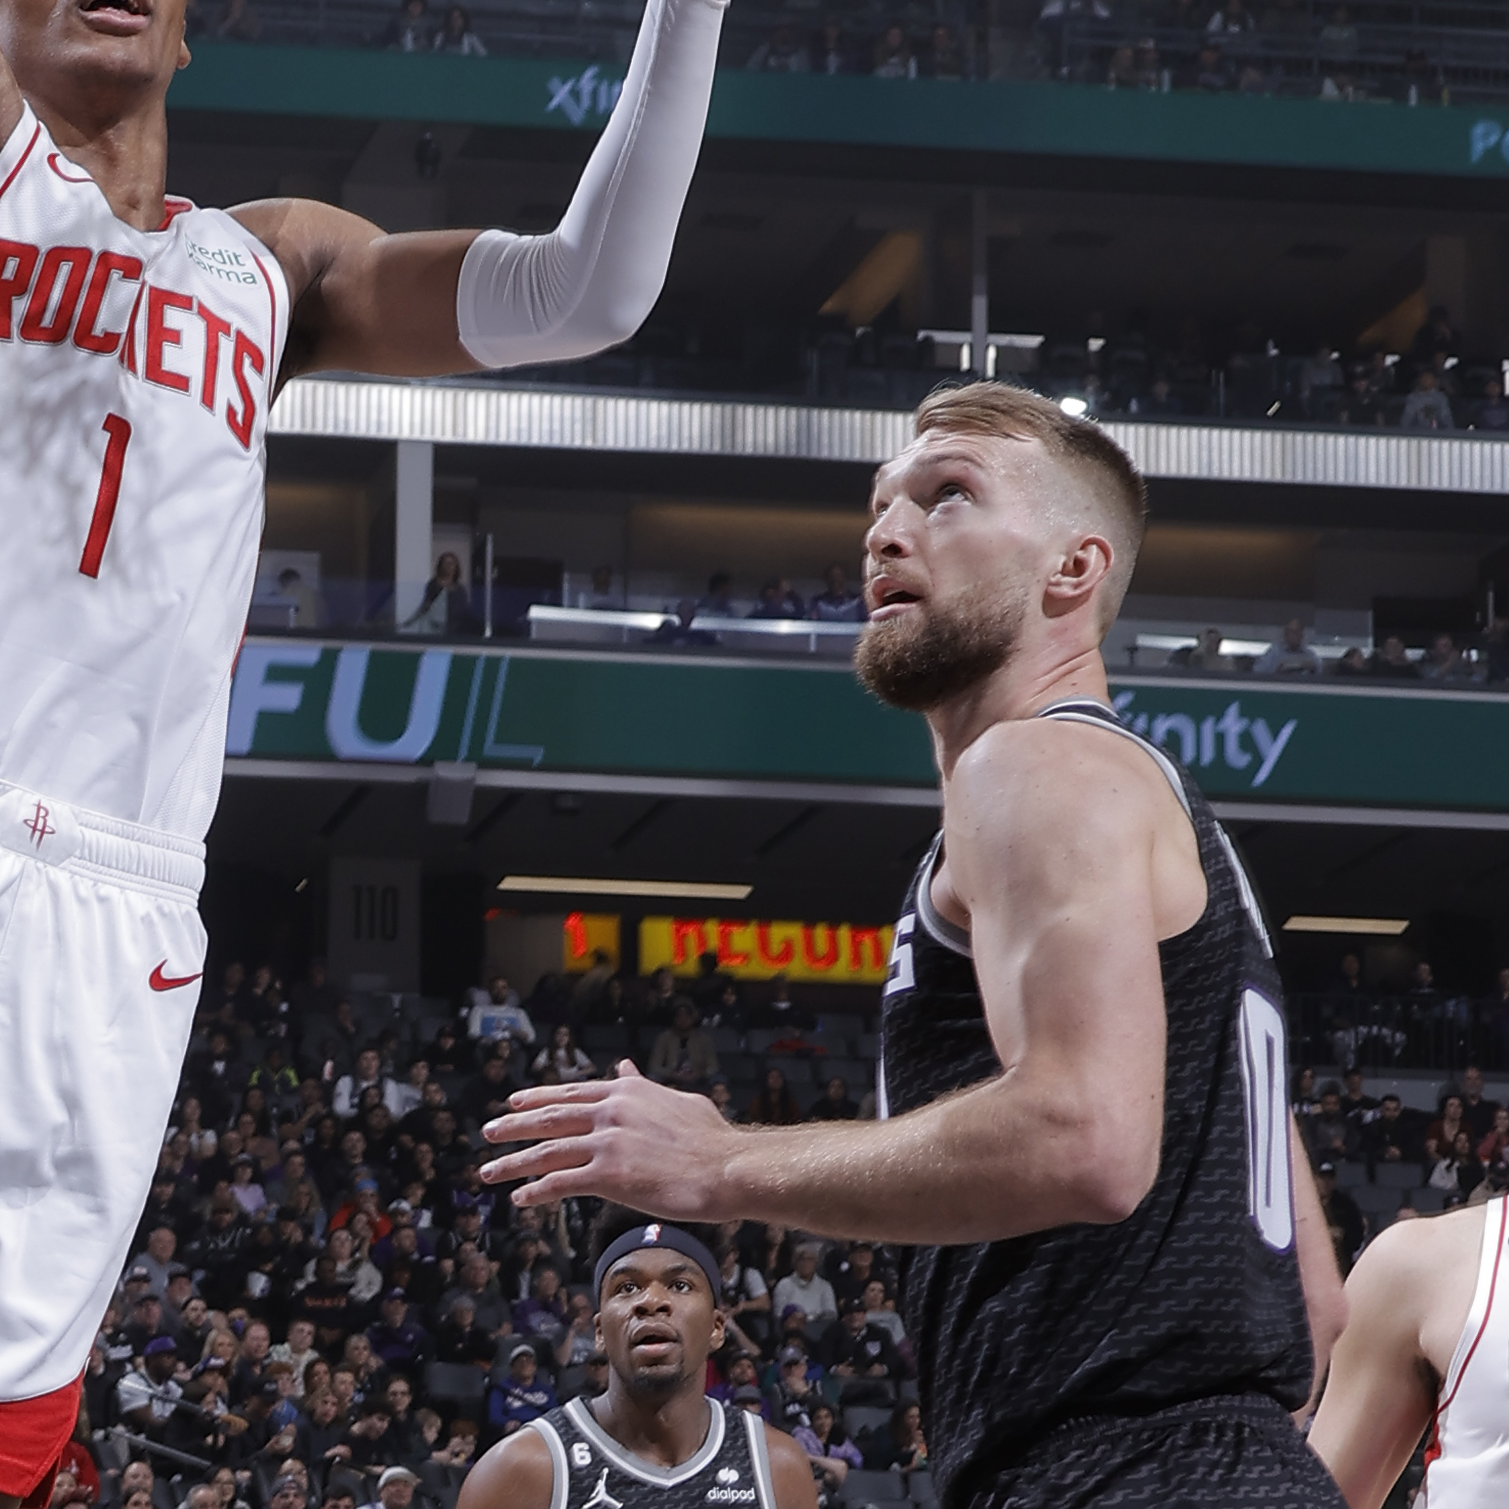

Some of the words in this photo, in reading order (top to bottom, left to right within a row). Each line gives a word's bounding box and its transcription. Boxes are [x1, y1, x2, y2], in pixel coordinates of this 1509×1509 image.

[191, 255, 258, 285] arma
[78, 412, 132, 580] 1
[352, 883, 400, 942] 110
[571, 1442, 593, 1467] 6
[705, 1486, 756, 1505] dialpad
